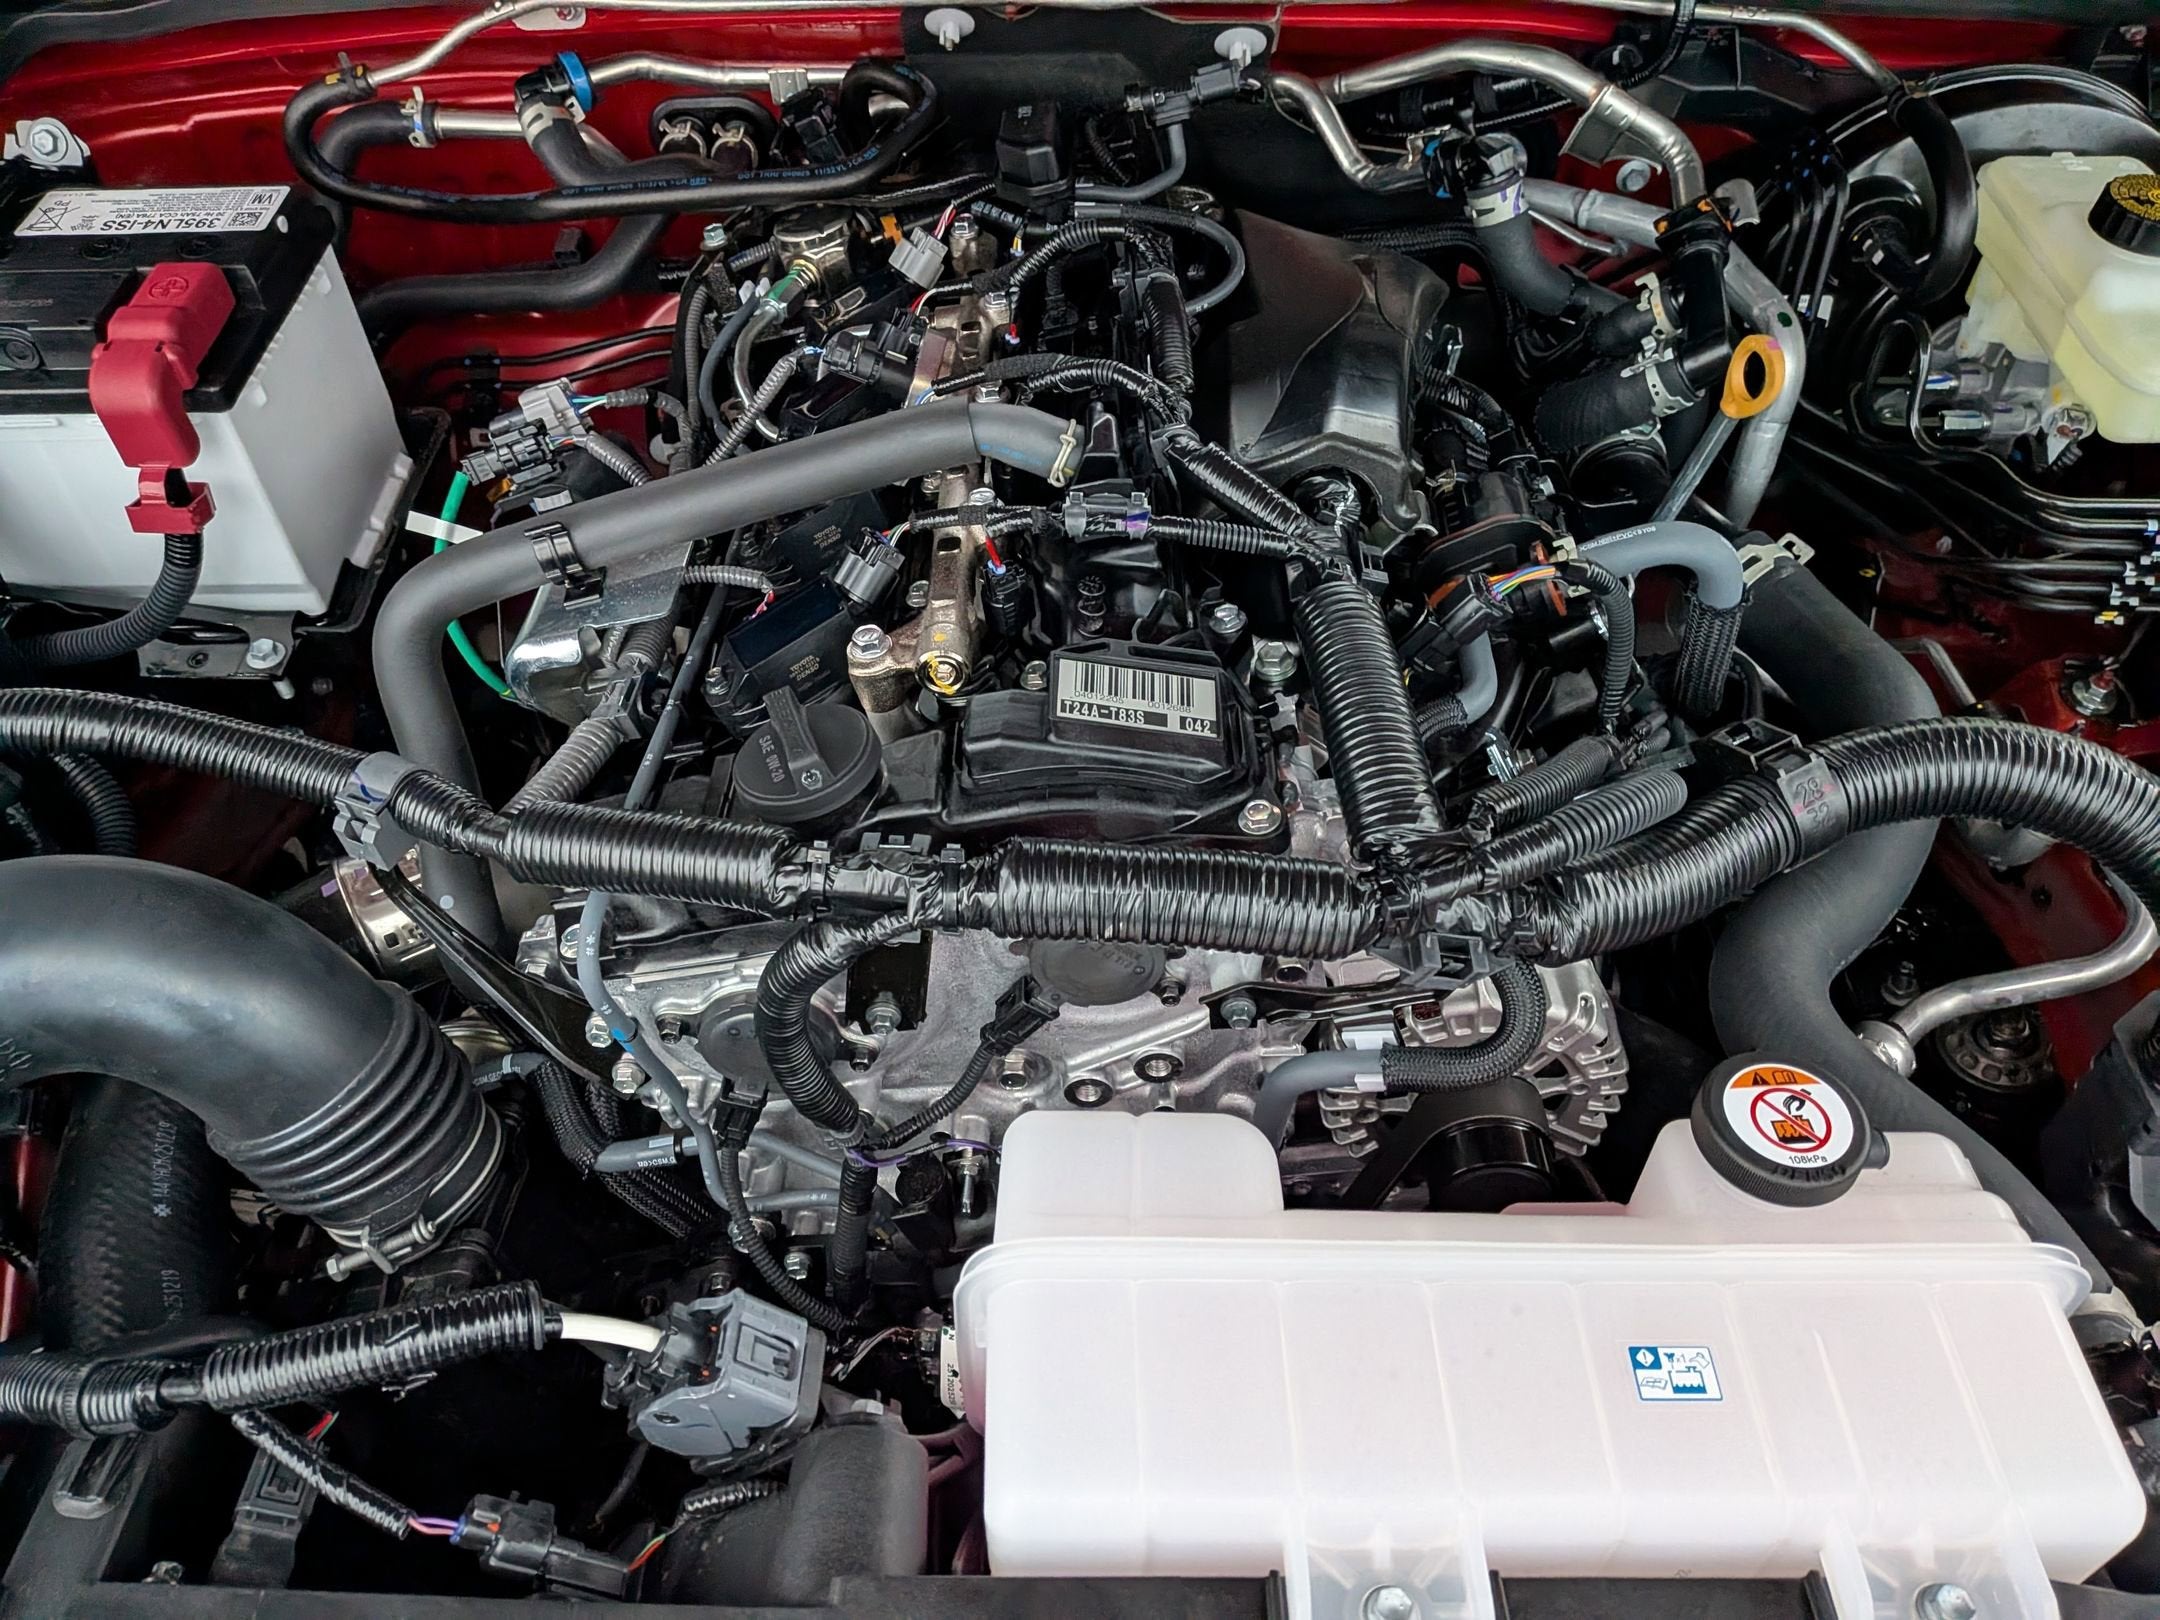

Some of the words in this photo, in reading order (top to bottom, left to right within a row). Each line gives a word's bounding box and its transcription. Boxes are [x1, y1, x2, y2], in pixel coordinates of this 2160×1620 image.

[251, 194, 273, 204] VM
[100, 216, 221, 231] 395LN4-ISS
[1074, 690, 1124, 705] 04012205
[1147, 701, 1192, 714] 0012688
[1063, 700, 1145, 725] T24A-T83S
[1185, 719, 1211, 734] 042
[759, 735, 775, 754] SAE
[1794, 777, 1825, 809] 28
[1788, 1154, 1828, 1165] 108kPa
